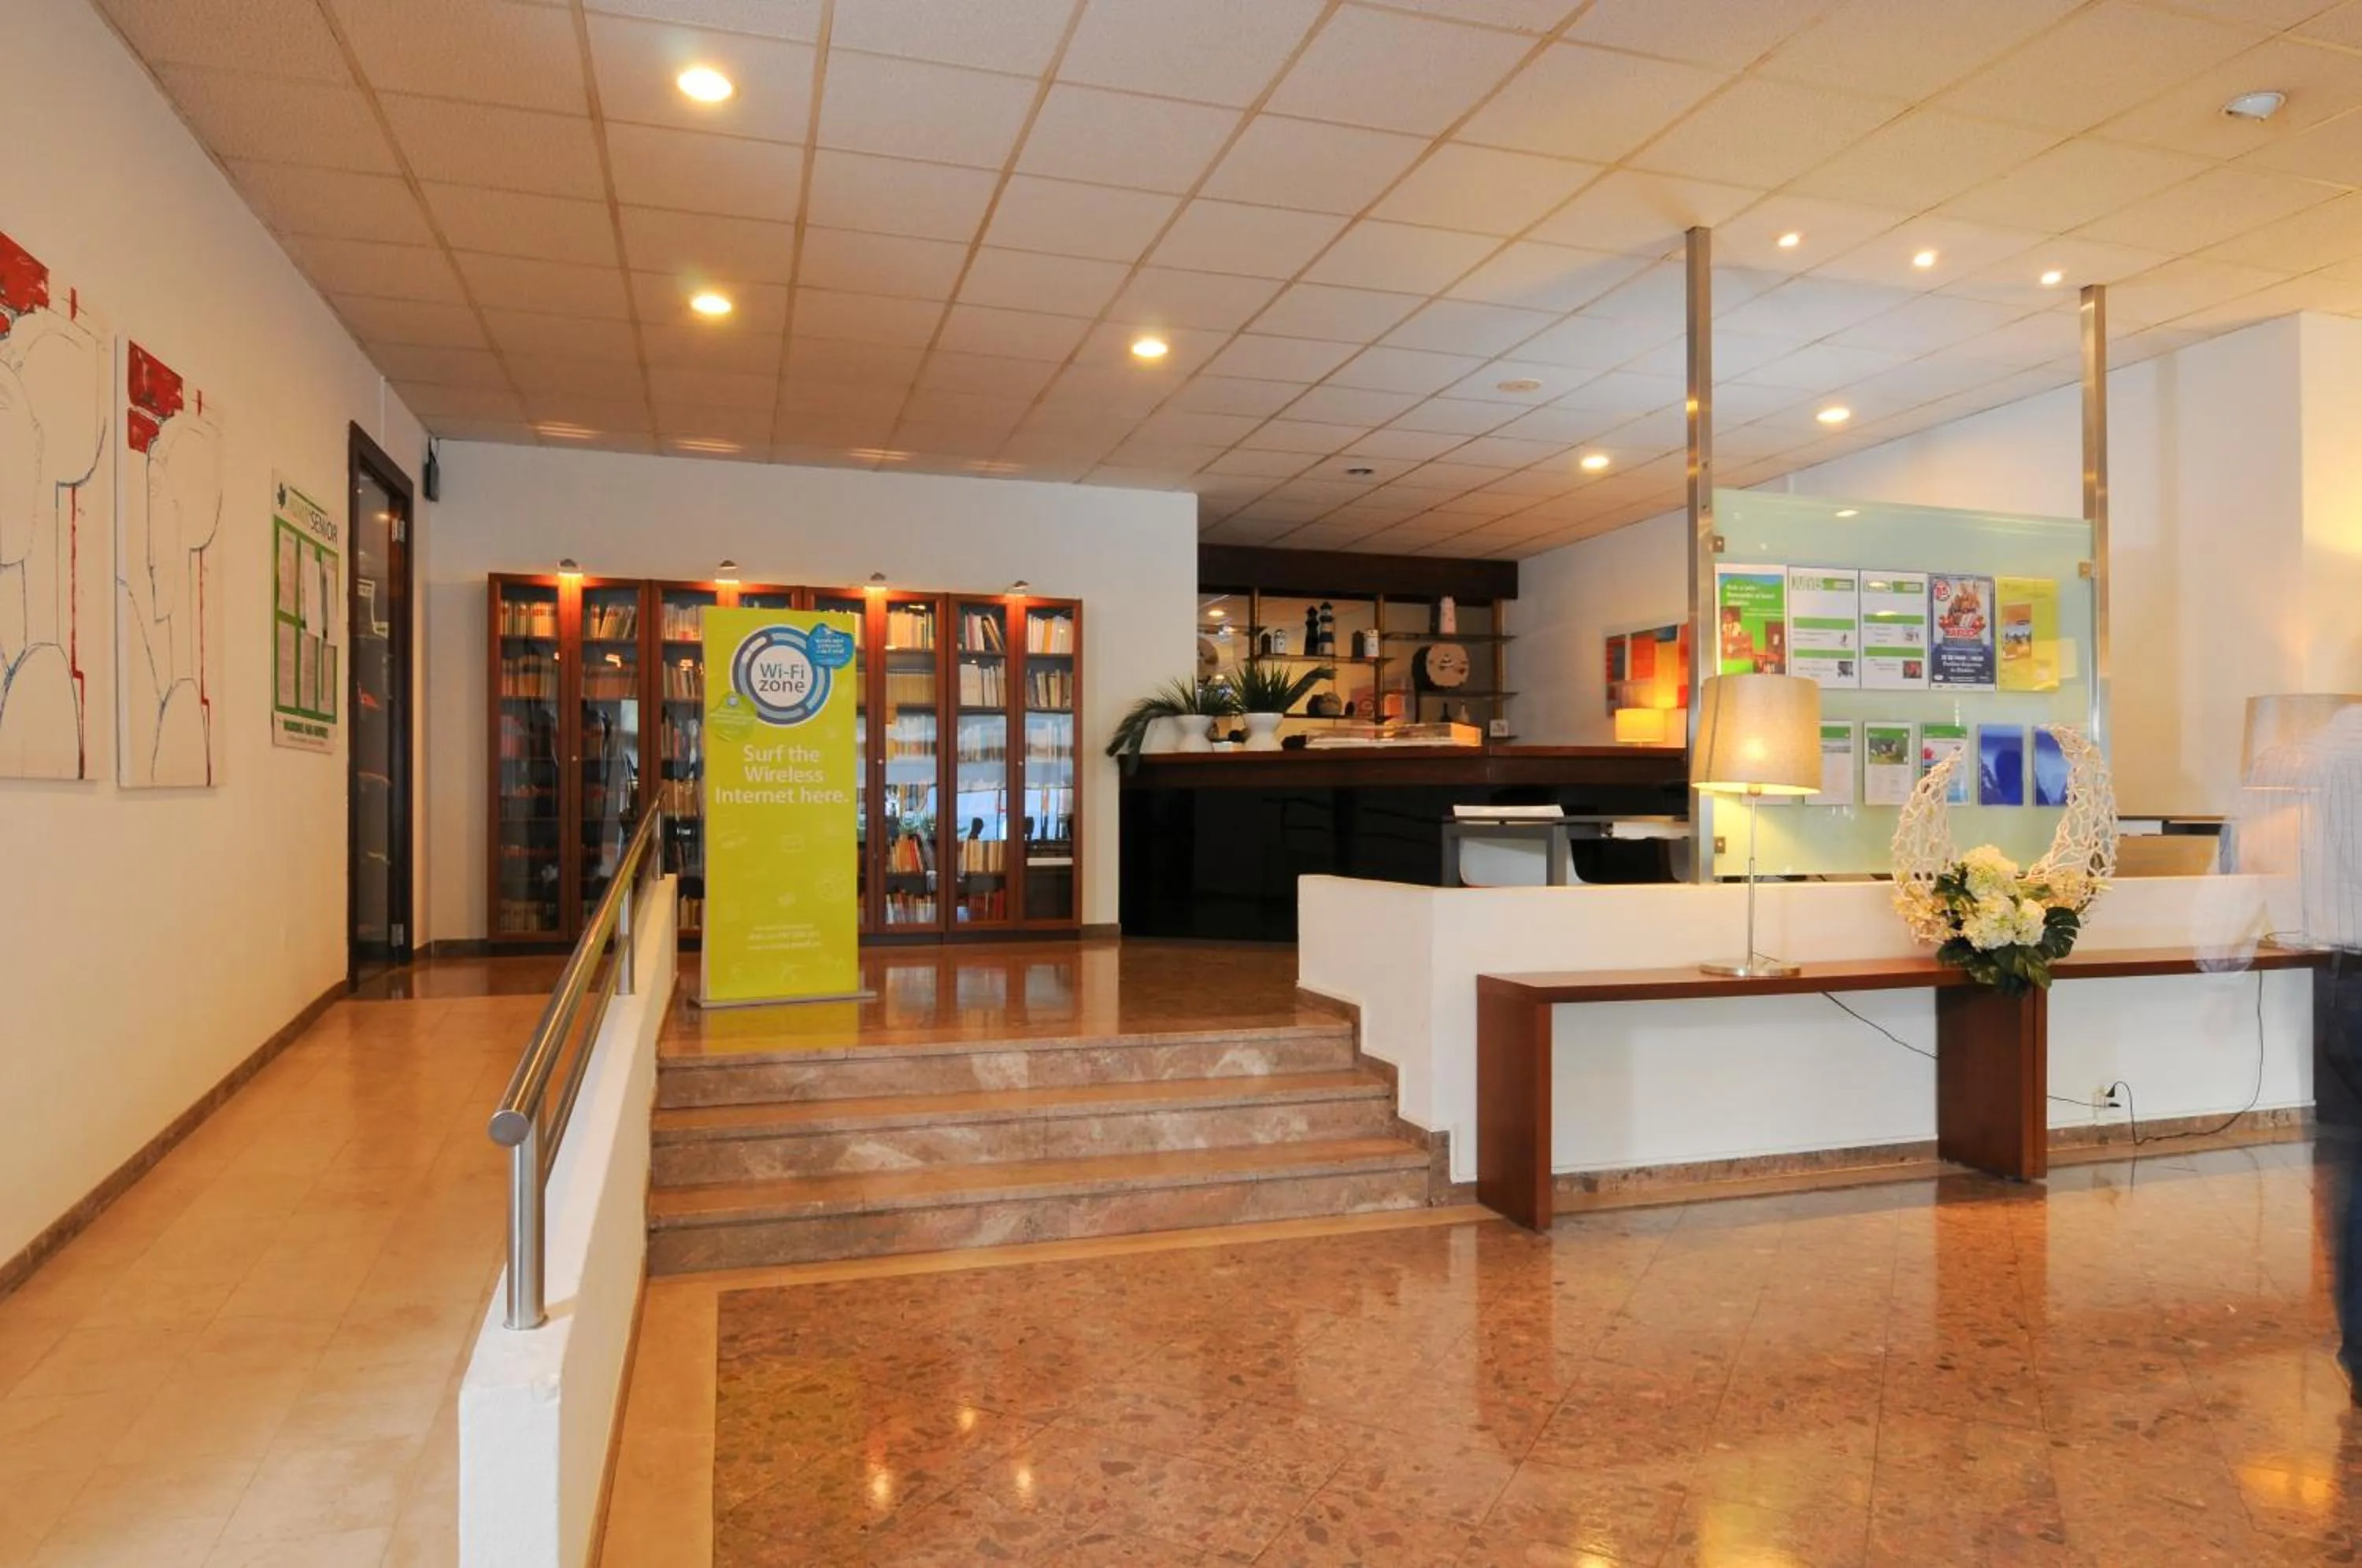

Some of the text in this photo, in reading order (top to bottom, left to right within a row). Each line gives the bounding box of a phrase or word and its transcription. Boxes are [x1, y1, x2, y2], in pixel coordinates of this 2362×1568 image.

[760, 662, 805, 679] Wi-Fi
[759, 679, 805, 693] zone
[743, 745, 820, 762] Surf the
[743, 766, 825, 782] Wireless
[715, 787, 850, 804] Internet here.
